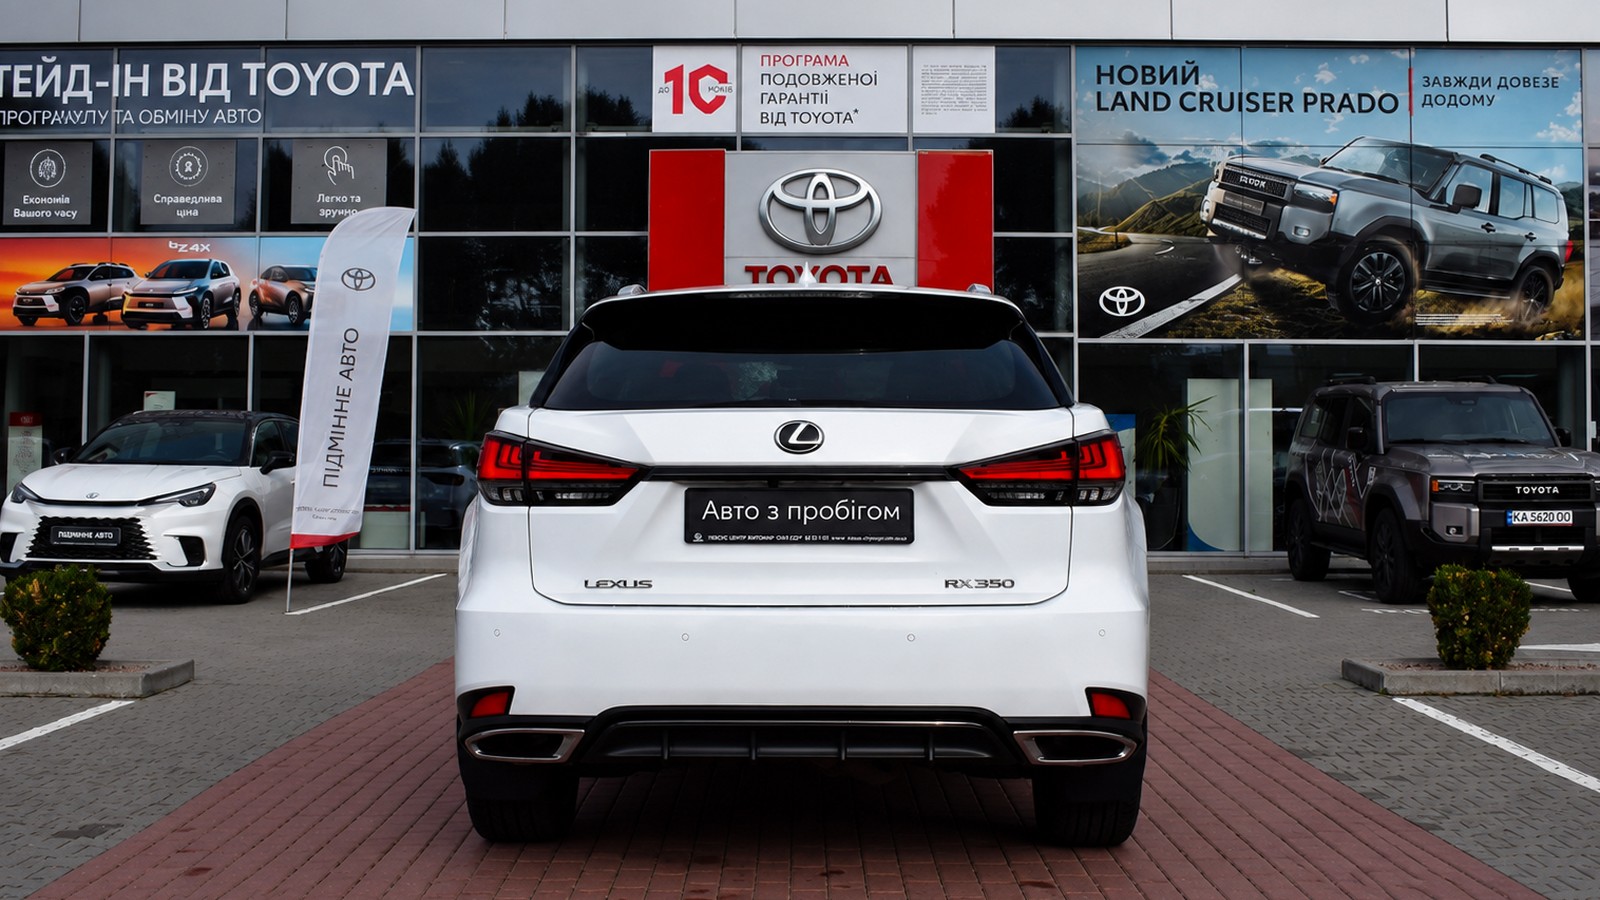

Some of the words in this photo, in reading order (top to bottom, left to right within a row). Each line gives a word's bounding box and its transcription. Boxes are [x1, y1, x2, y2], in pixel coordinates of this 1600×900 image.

[761, 54, 849, 67] ПРОГРАМА
[760, 70, 878, 88] ПОДОВЖЕНОЇ
[1096, 60, 1199, 86] НОВИЙ
[163, 62, 231, 104] ВІД
[243, 62, 414, 96] TOYOTA
[1422, 75, 1492, 90] ЗАВЖДИ
[1497, 76, 1560, 91] ДОВЕЗЕ
[760, 90, 828, 105] ГАРАНТІЇ
[1096, 91, 1171, 112] LAND
[1179, 91, 1295, 113] CRUISER
[1303, 92, 1399, 114] PRADO
[1422, 94, 1495, 108] ДОДОМУ
[114, 109, 134, 125] ТА
[139, 109, 209, 125] ОБМІНУ
[213, 108, 262, 124] АВТО
[760, 111, 787, 127] ВІД
[153, 193, 223, 206] Справедлива
[316, 193, 348, 203] Легко
[350, 195, 361, 203] та
[176, 209, 199, 219] ціна
[322, 385, 352, 488] ПІДМІННЕ
[338, 328, 360, 382] АВТО
[1515, 486, 1560, 494] TOYOTA
[701, 500, 760, 521] Авто
[767, 505, 779, 520] з
[787, 499, 901, 525] пробігом
[1530, 511, 1555, 522] 5620
[584, 579, 653, 590] LEXUS
